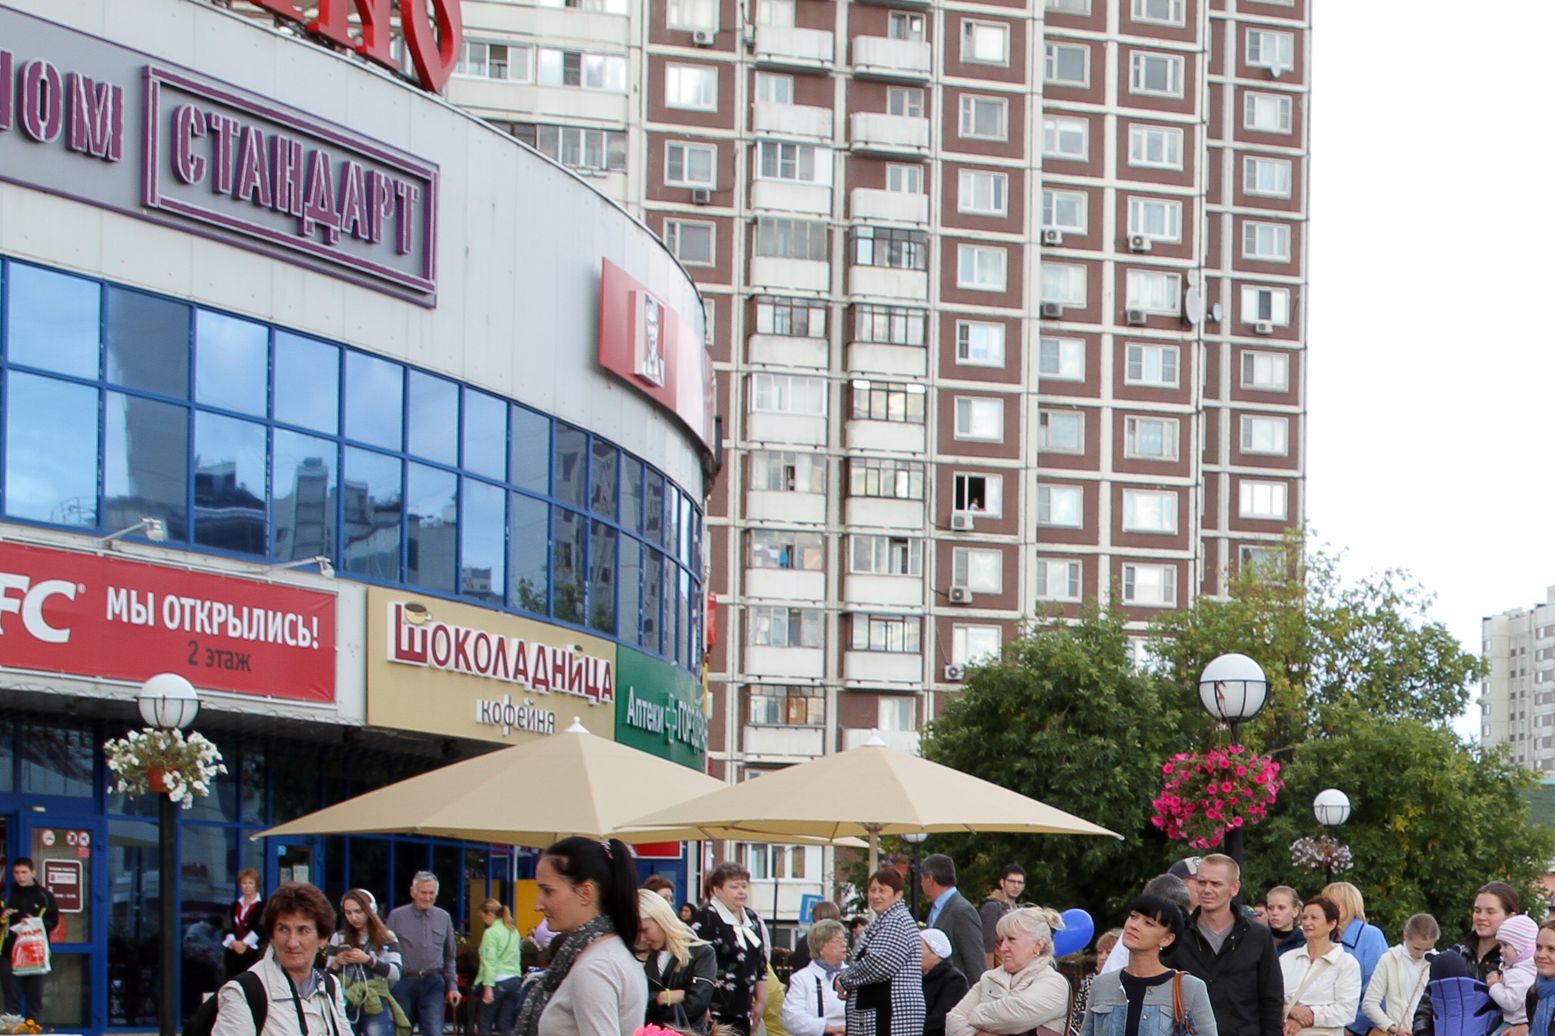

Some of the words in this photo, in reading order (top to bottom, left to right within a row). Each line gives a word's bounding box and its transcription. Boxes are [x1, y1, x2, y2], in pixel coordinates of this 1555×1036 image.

[172, 102, 420, 255] СТАНДАРТ
[106, 585, 155, 627] МЫ
[162, 594, 319, 650] ОТКРЫЛИСЬ!
[187, 640, 199, 666] 2
[204, 646, 252, 673] этаж
[390, 602, 614, 704] ШОКОЛАДНИЦА
[479, 694, 556, 736] кофейня
[627, 685, 664, 735] Аптеки
